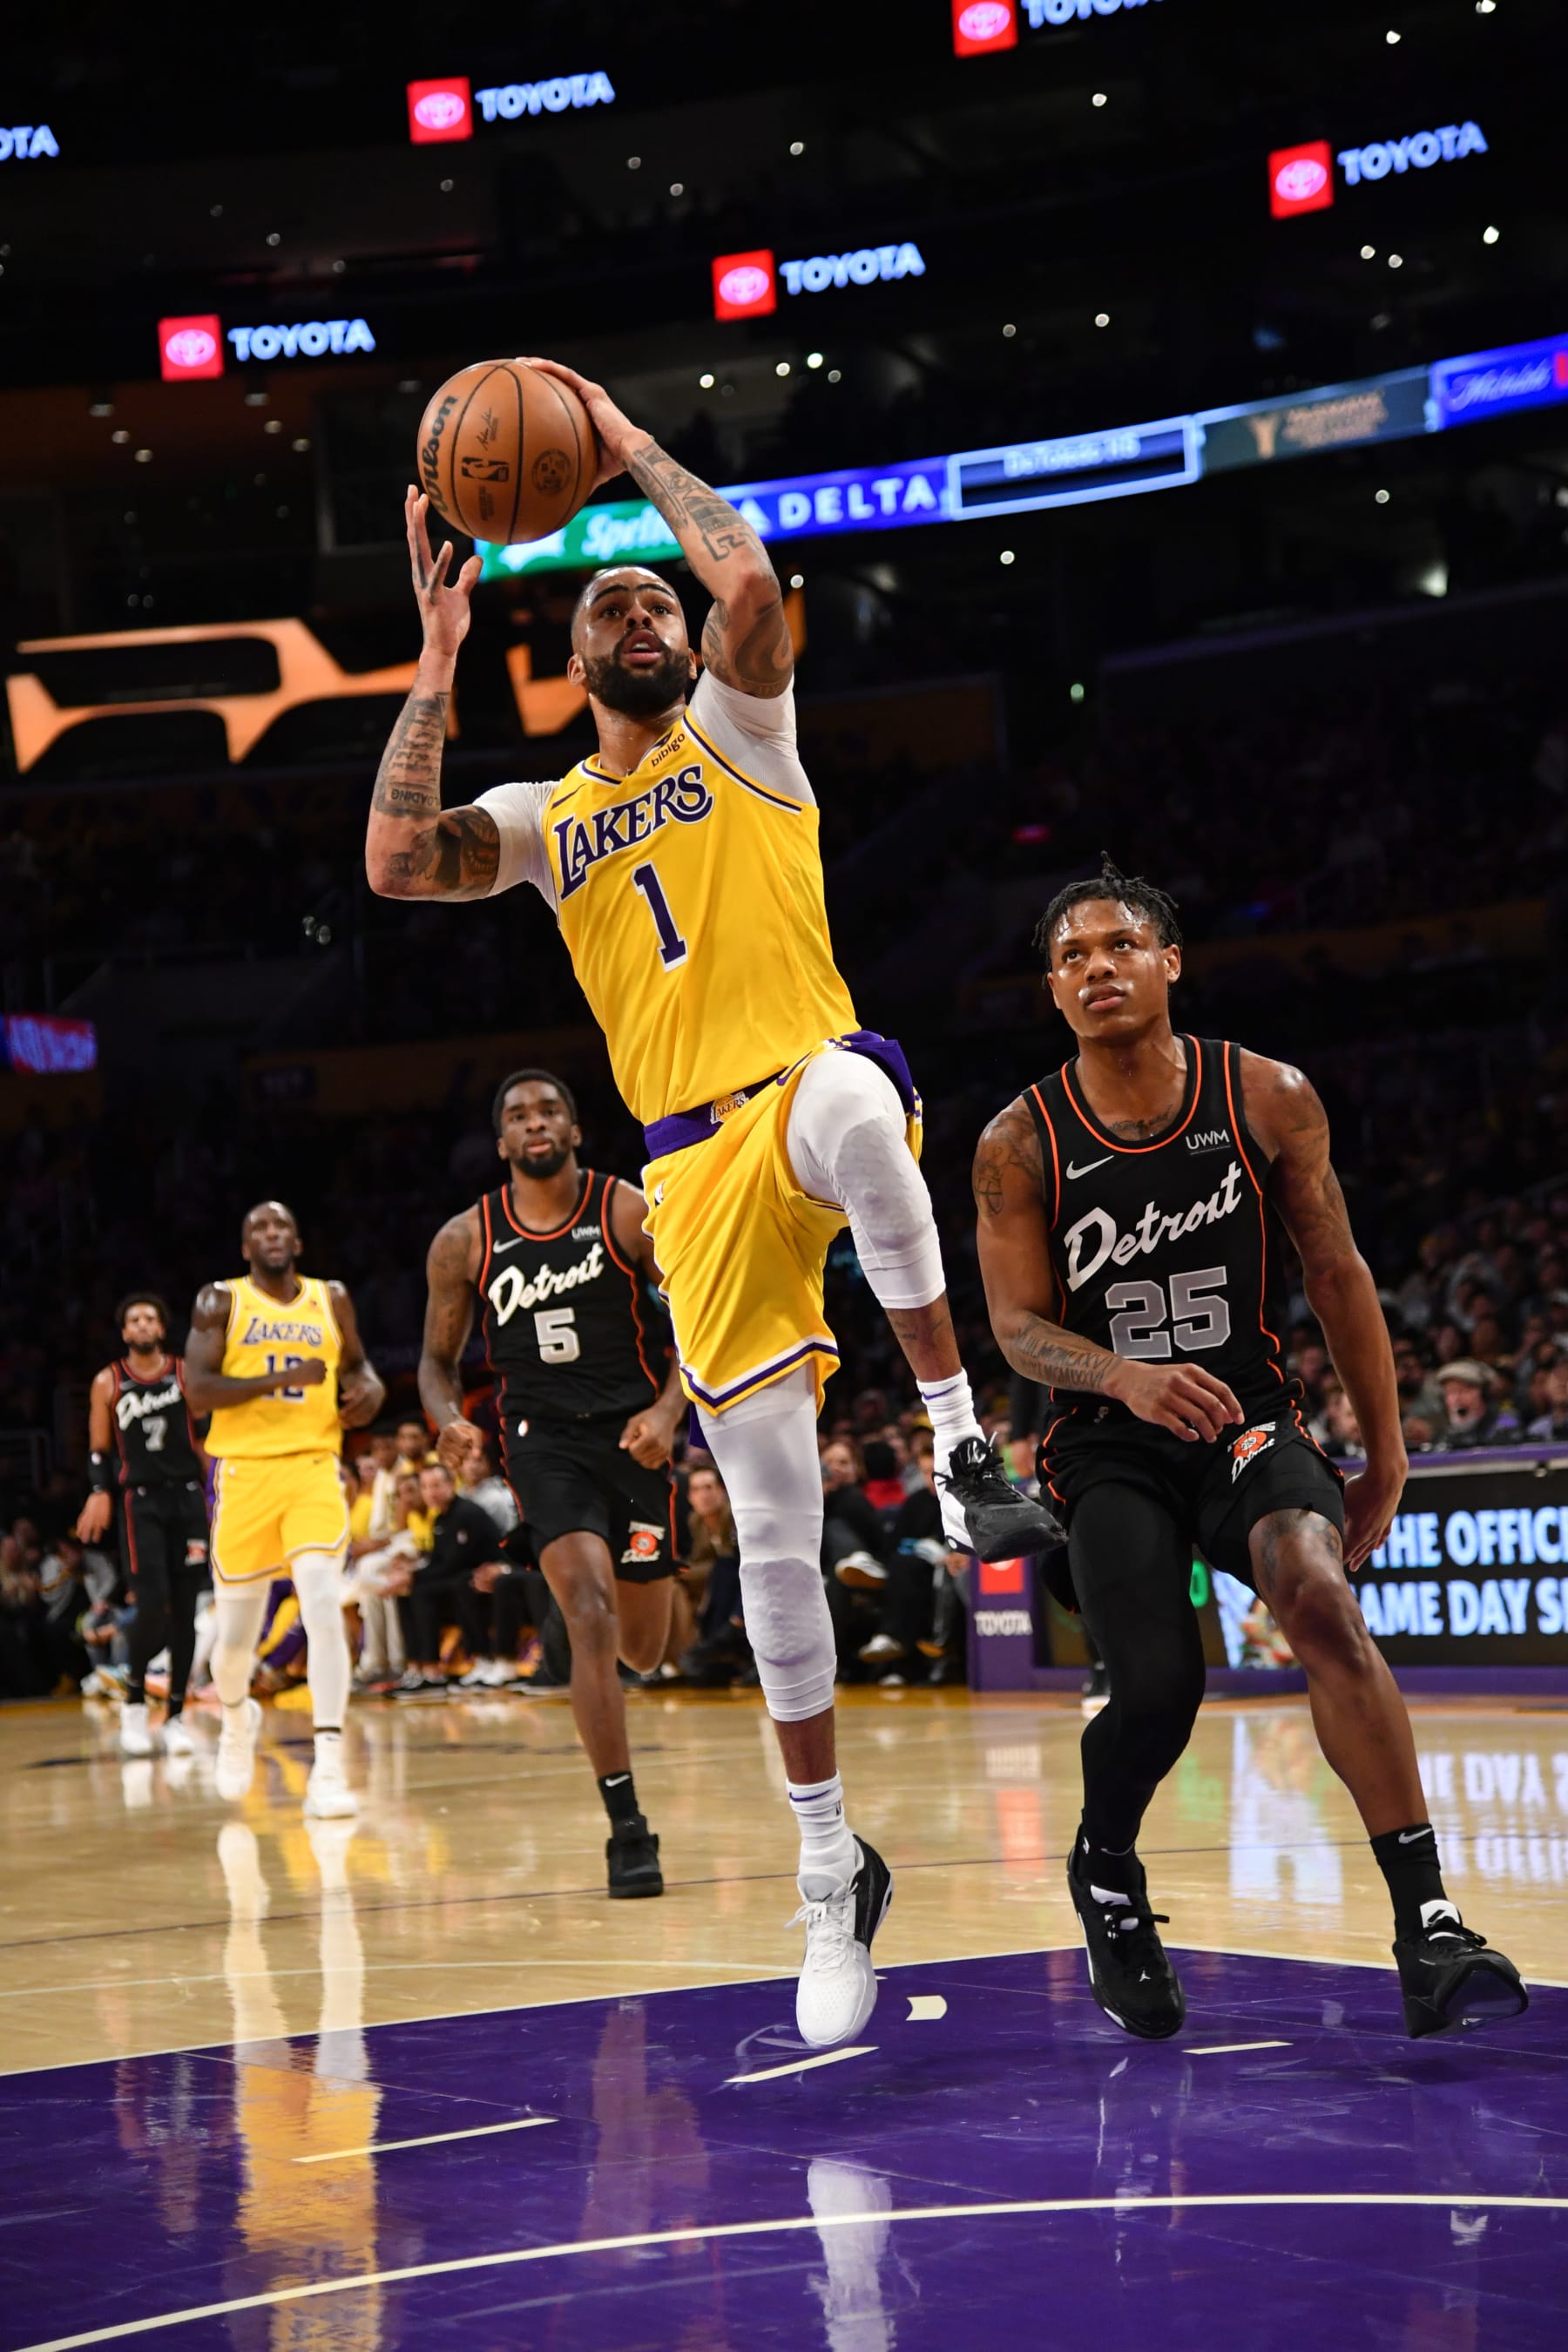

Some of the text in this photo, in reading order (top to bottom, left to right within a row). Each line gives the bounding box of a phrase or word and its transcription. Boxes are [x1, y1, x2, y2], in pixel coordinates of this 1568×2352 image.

[476, 71, 616, 121] TOYOTA
[1337, 120, 1489, 186] TOYOTA
[781, 241, 926, 295] TOYOTA
[227, 318, 376, 362] TOYOTA
[778, 474, 939, 531] DELTA
[651, 733, 686, 768] bibigo
[552, 765, 714, 902] LAKERS
[631, 858, 689, 974] 1
[709, 1095, 748, 1125] LAKERS
[1186, 1129, 1230, 1150] UWM
[571, 1225, 601, 1240] UWM
[1063, 1160, 1243, 1293] Detroit
[487, 1241, 605, 1327] Detroit
[241, 1315, 323, 1348] LAKERS
[533, 1308, 581, 1364] 5
[1105, 1265, 1232, 1360] 25
[141, 1415, 169, 1452] 7
[1371, 1511, 1443, 1569] HE
[973, 1610, 1034, 1637] TOYOTA
[1349, 1580, 1444, 1637] AME
[1446, 1577, 1531, 1637] DAY
